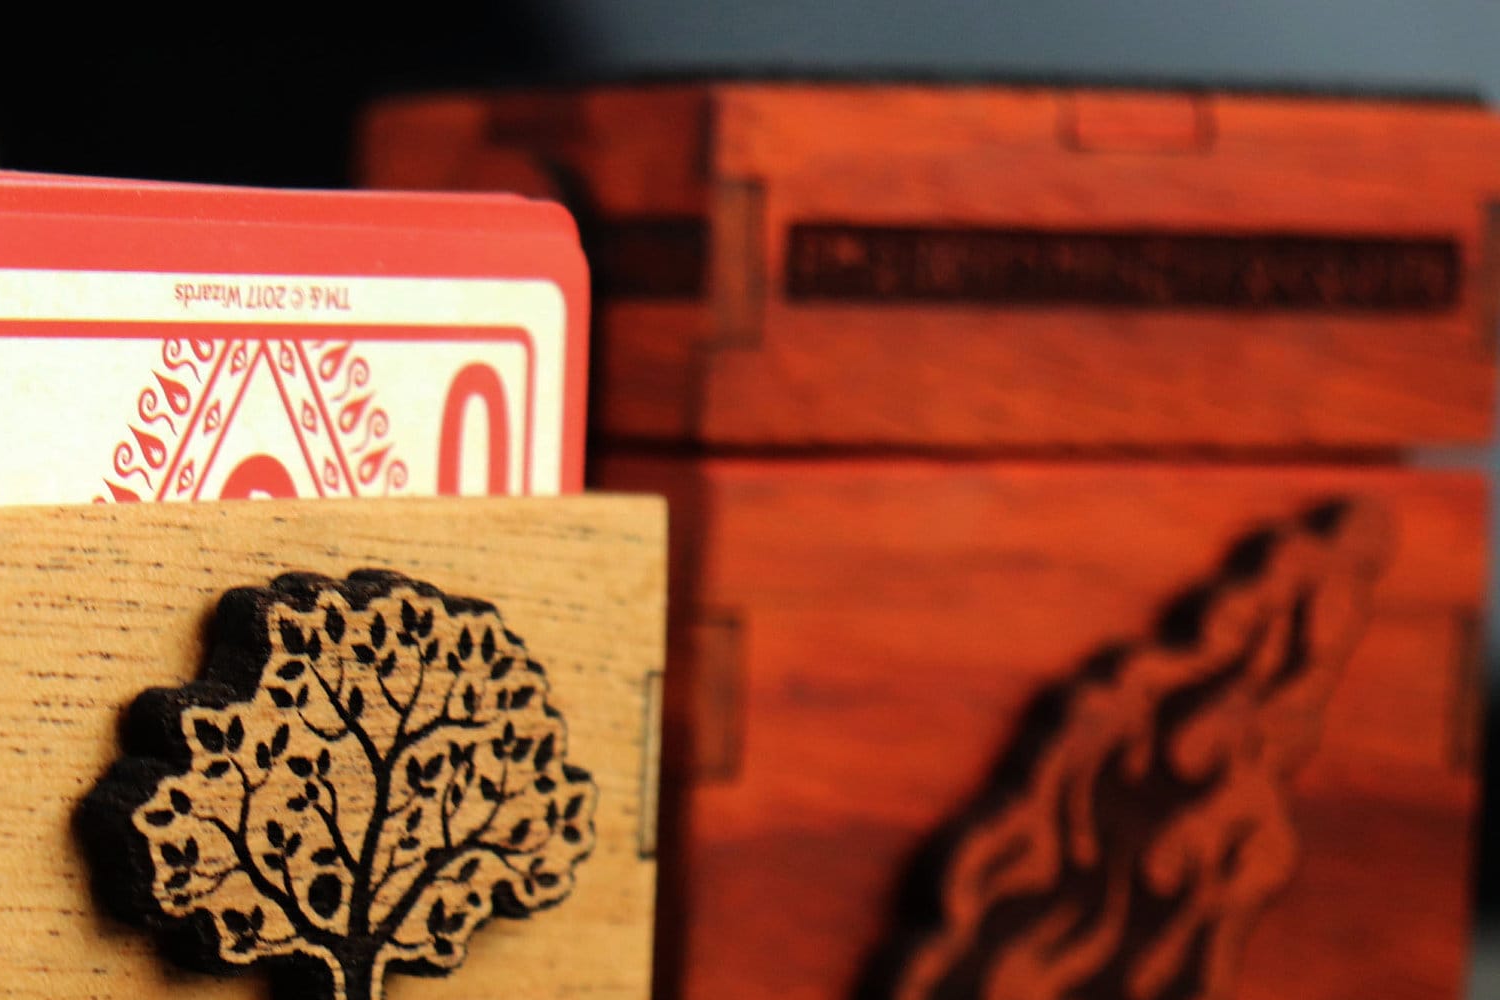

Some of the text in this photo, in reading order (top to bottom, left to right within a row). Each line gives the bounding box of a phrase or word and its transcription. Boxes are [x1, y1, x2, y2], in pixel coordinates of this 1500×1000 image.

[174, 283, 243, 309] Wizards
[246, 284, 287, 310] 2017
[326, 286, 352, 311] TM
